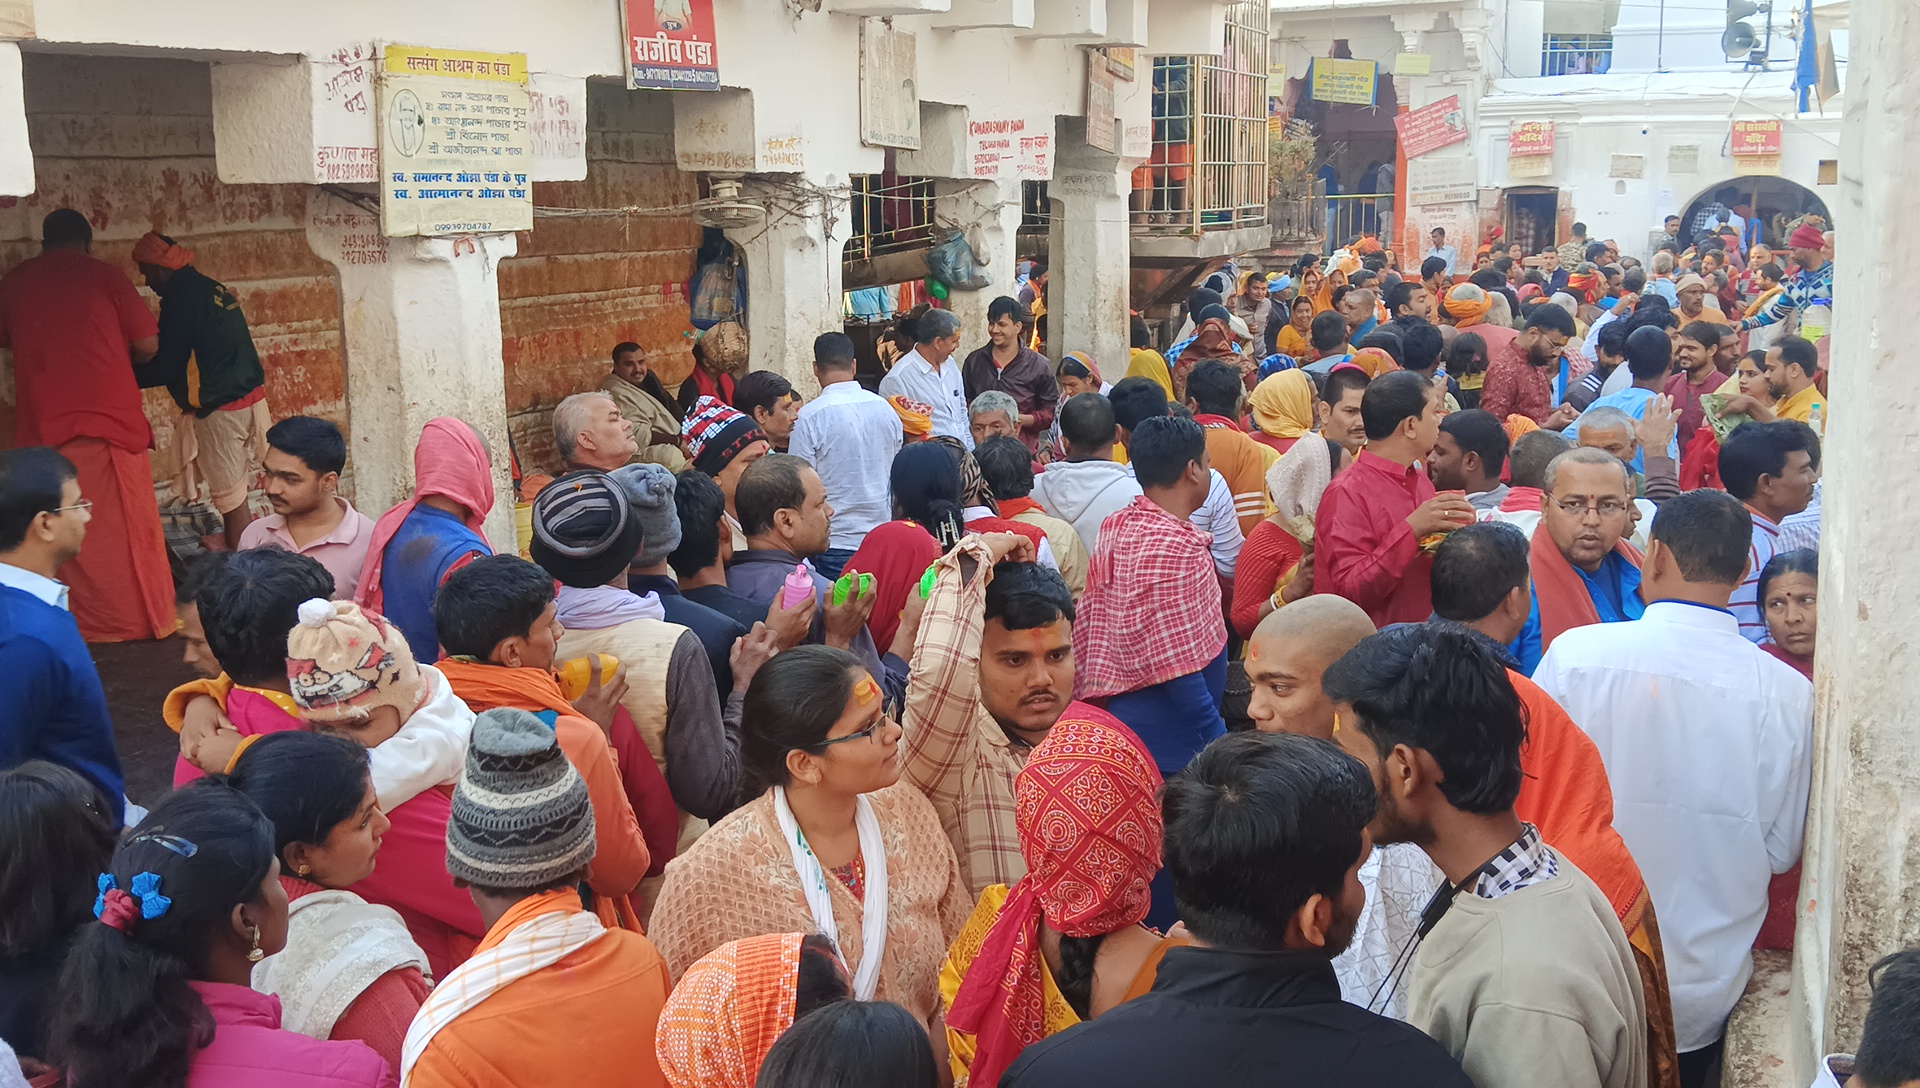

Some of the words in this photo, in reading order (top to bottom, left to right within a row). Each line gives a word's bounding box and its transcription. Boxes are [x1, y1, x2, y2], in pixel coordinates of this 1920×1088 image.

[633, 31, 682, 63] राजीव
[684, 34, 712, 66] पंडा
[406, 53, 439, 71] सत्संग
[442, 58, 474, 74] आश्रम
[476, 61, 490, 75] का
[493, 58, 511, 76] पंडा
[459, 128, 488, 141] বিনোদ
[456, 169, 481, 184] ओझा
[484, 170, 500, 184] पंडा
[502, 170, 511, 183] के
[514, 172, 527, 186] पुत्र
[478, 186, 506, 199] ओझा
[508, 186, 527, 199] पंडा
[434, 222, 492, 232] 09939704787
